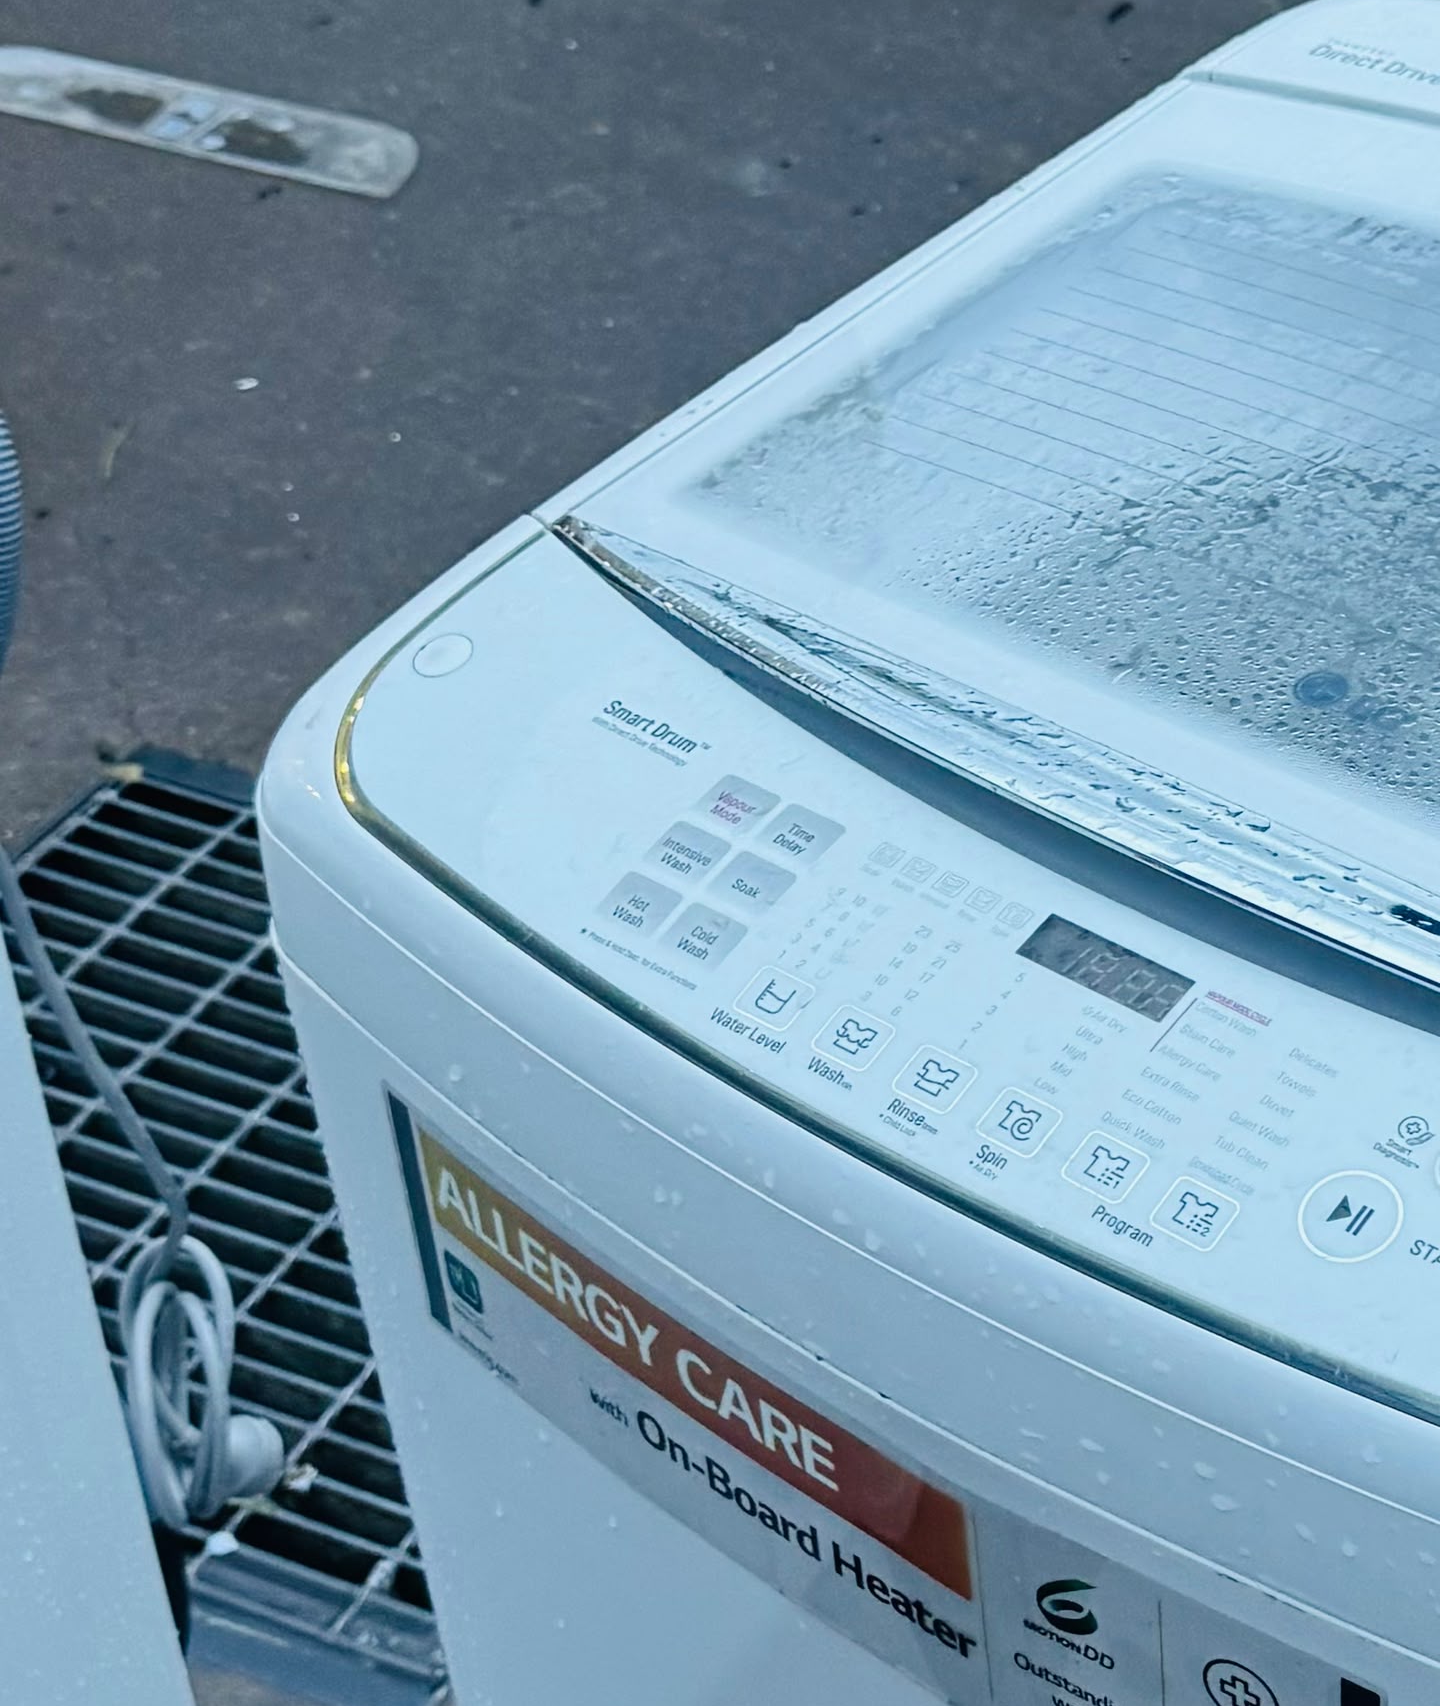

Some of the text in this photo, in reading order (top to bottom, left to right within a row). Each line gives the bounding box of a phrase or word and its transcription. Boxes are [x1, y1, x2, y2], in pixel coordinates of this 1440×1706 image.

[1309, 44, 1384, 70] Direct
[603, 700, 655, 732] Smart
[717, 791, 756, 814] Vapour
[710, 805, 742, 825] Mode
[773, 833, 807, 856] Delay
[788, 823, 815, 843] Time
[662, 837, 712, 866] Intensive
[660, 852, 692, 875] Wash
[732, 878, 760, 898] Soak
[627, 894, 650, 913] Hot
[612, 905, 644, 928] Wash
[690, 926, 719, 946] Cold
[676, 936, 709, 960] Wash
[710, 1007, 787, 1054] Water Level
[1075, 1025, 1103, 1045] Ultra
[807, 1056, 844, 1086] Wash
[887, 1098, 925, 1126] Rinse
[1215, 1135, 1235, 1153] Tub
[976, 1144, 1008, 1170] Spin
[1091, 1205, 1154, 1248] Program
[438, 1166, 840, 1491] ALLERGY CARE
[636, 1410, 821, 1562] On-Board
[831, 1540, 977, 1659] Heater
